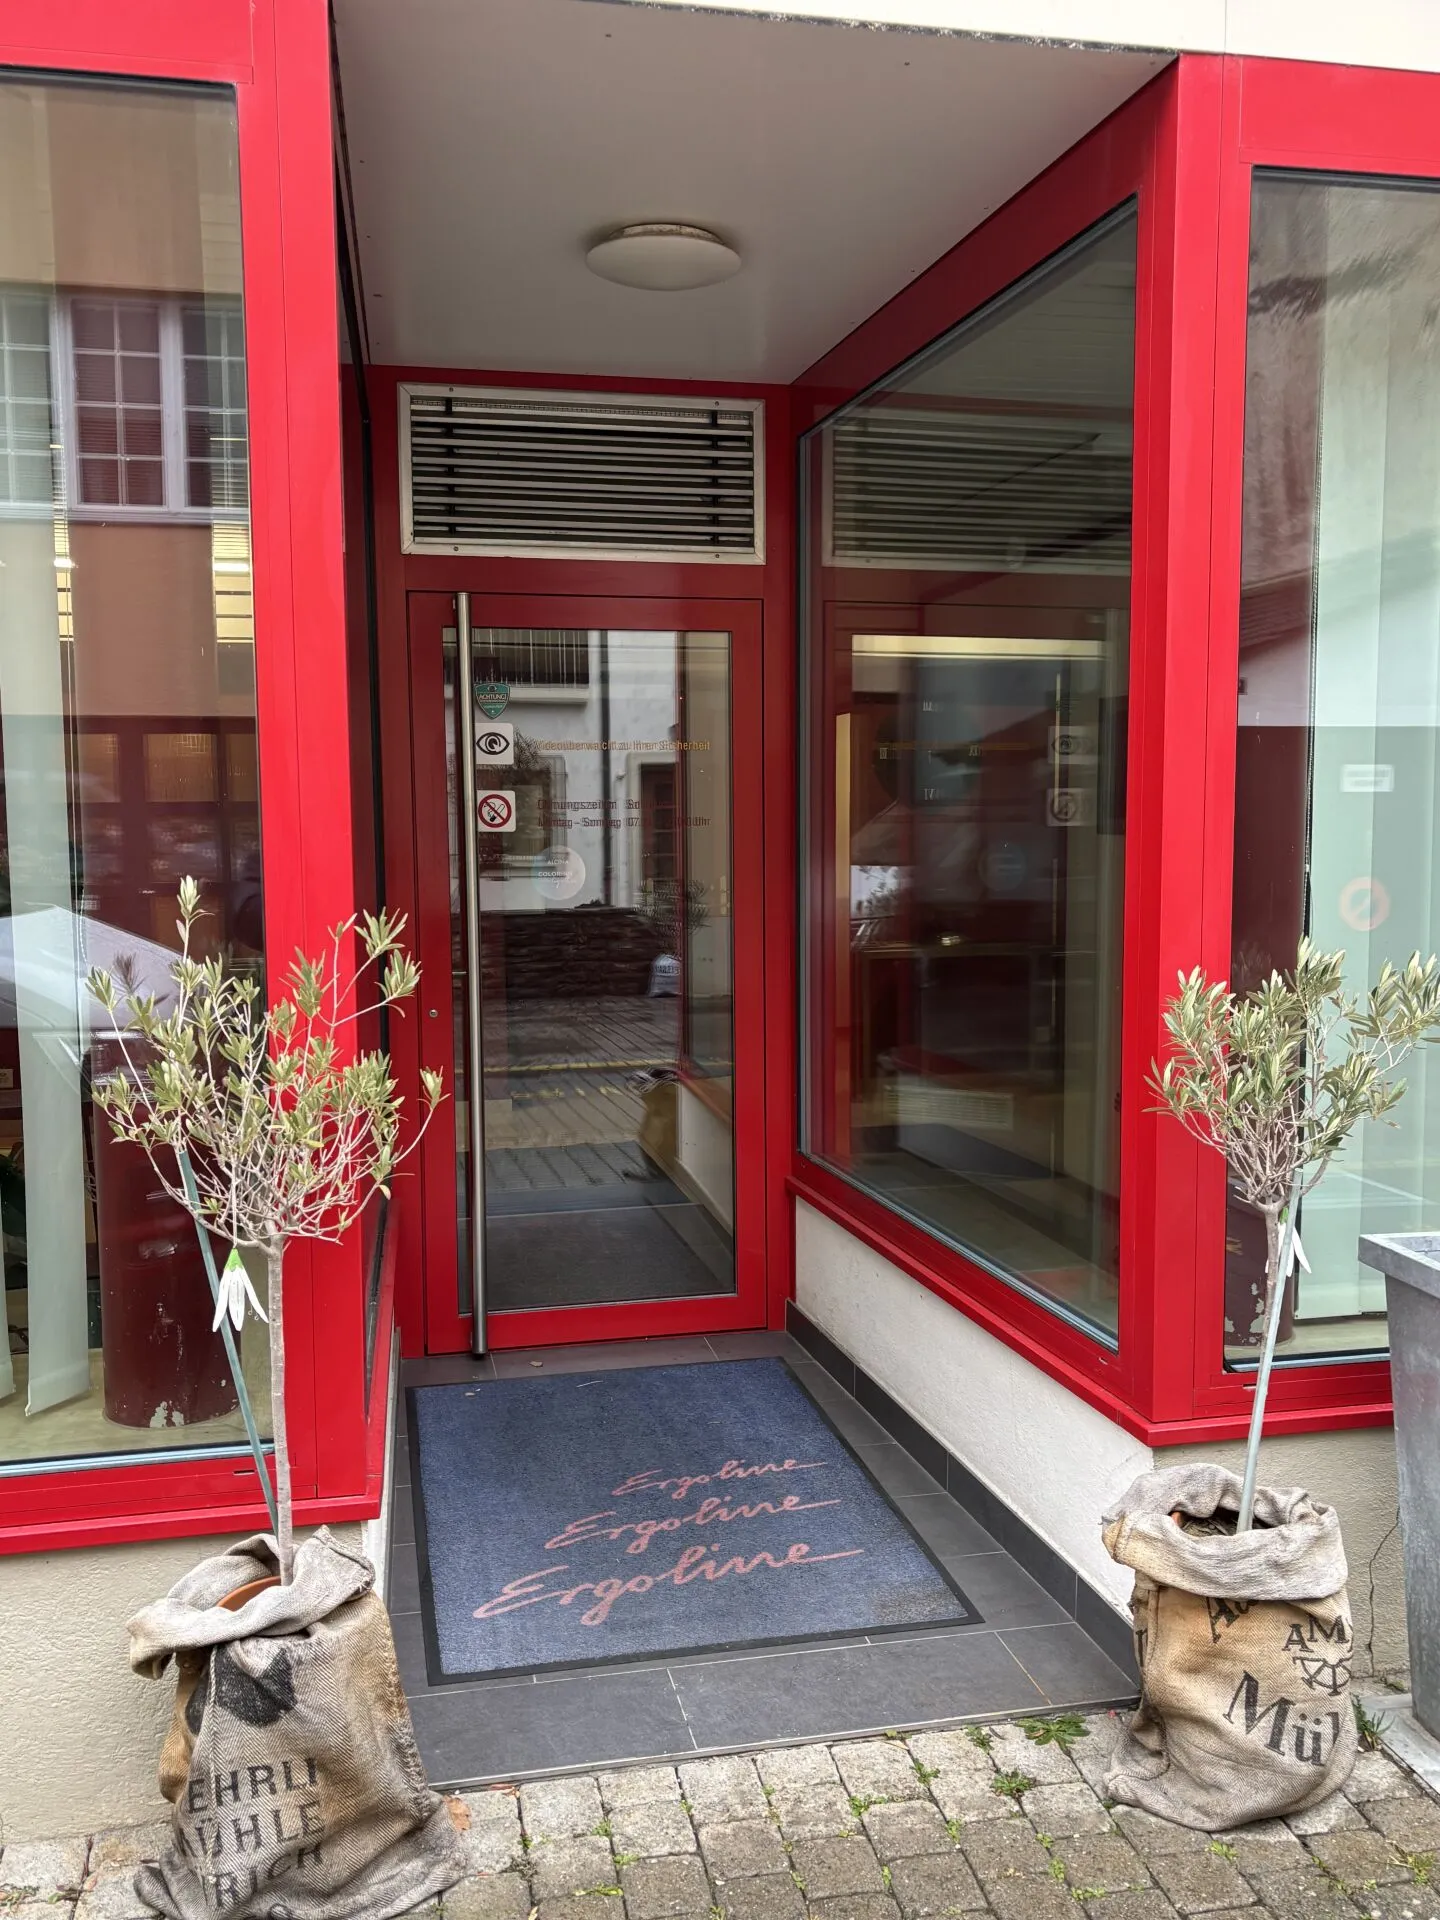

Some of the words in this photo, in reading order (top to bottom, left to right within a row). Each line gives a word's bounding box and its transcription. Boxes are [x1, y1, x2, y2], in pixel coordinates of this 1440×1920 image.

[612, 1459, 828, 1499] Ergoline
[544, 1495, 841, 1553] Ergoline
[472, 1543, 865, 1626] Ergoline
